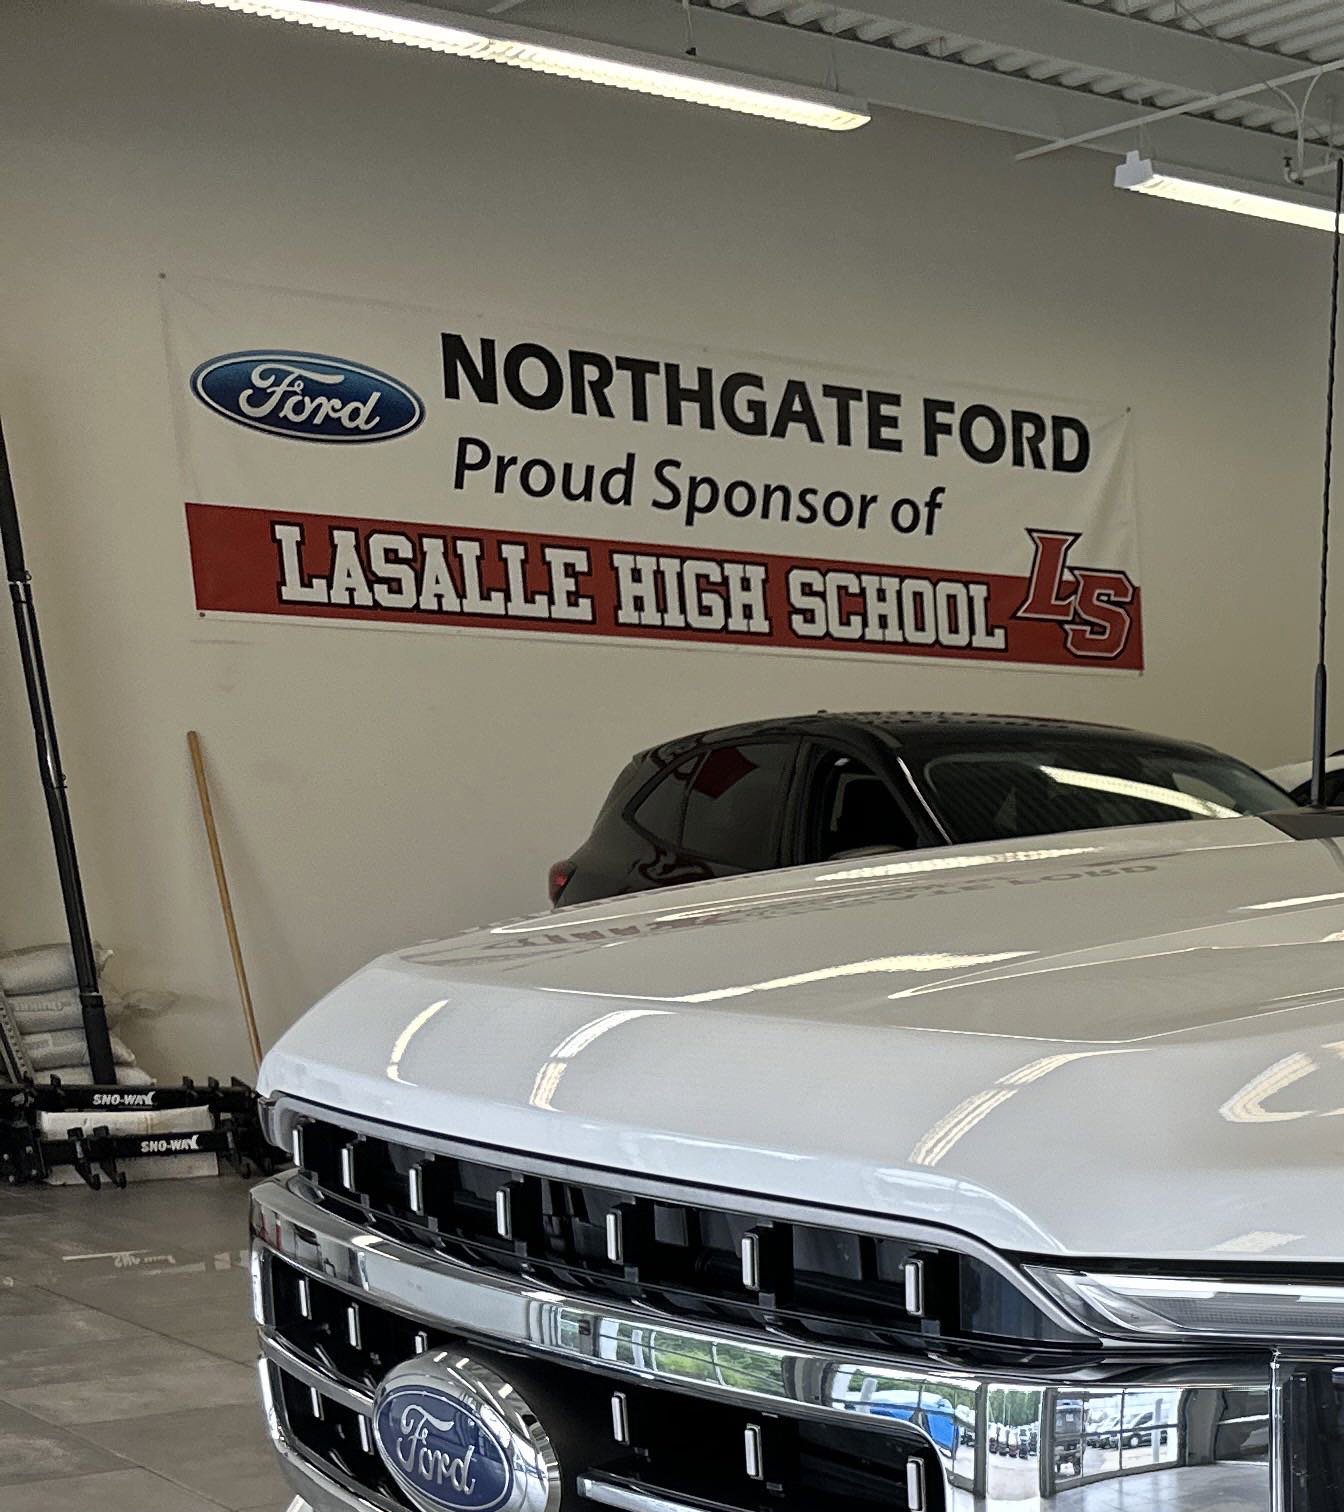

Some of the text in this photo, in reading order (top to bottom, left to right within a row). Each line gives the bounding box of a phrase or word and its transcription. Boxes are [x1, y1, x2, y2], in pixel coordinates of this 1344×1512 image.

[238, 364, 381, 431] Ford
[441, 332, 1091, 474] NORTHGATE FORD
[454, 437, 946, 535] Proud Sponsor of
[272, 522, 1008, 653] LASALLE HIGH SCHOOL
[1009, 527, 1141, 660] LS
[92, 1091, 156, 1106] SNO-WAY
[141, 1134, 200, 1153] SNO-WAY
[396, 1404, 477, 1496] Ford
